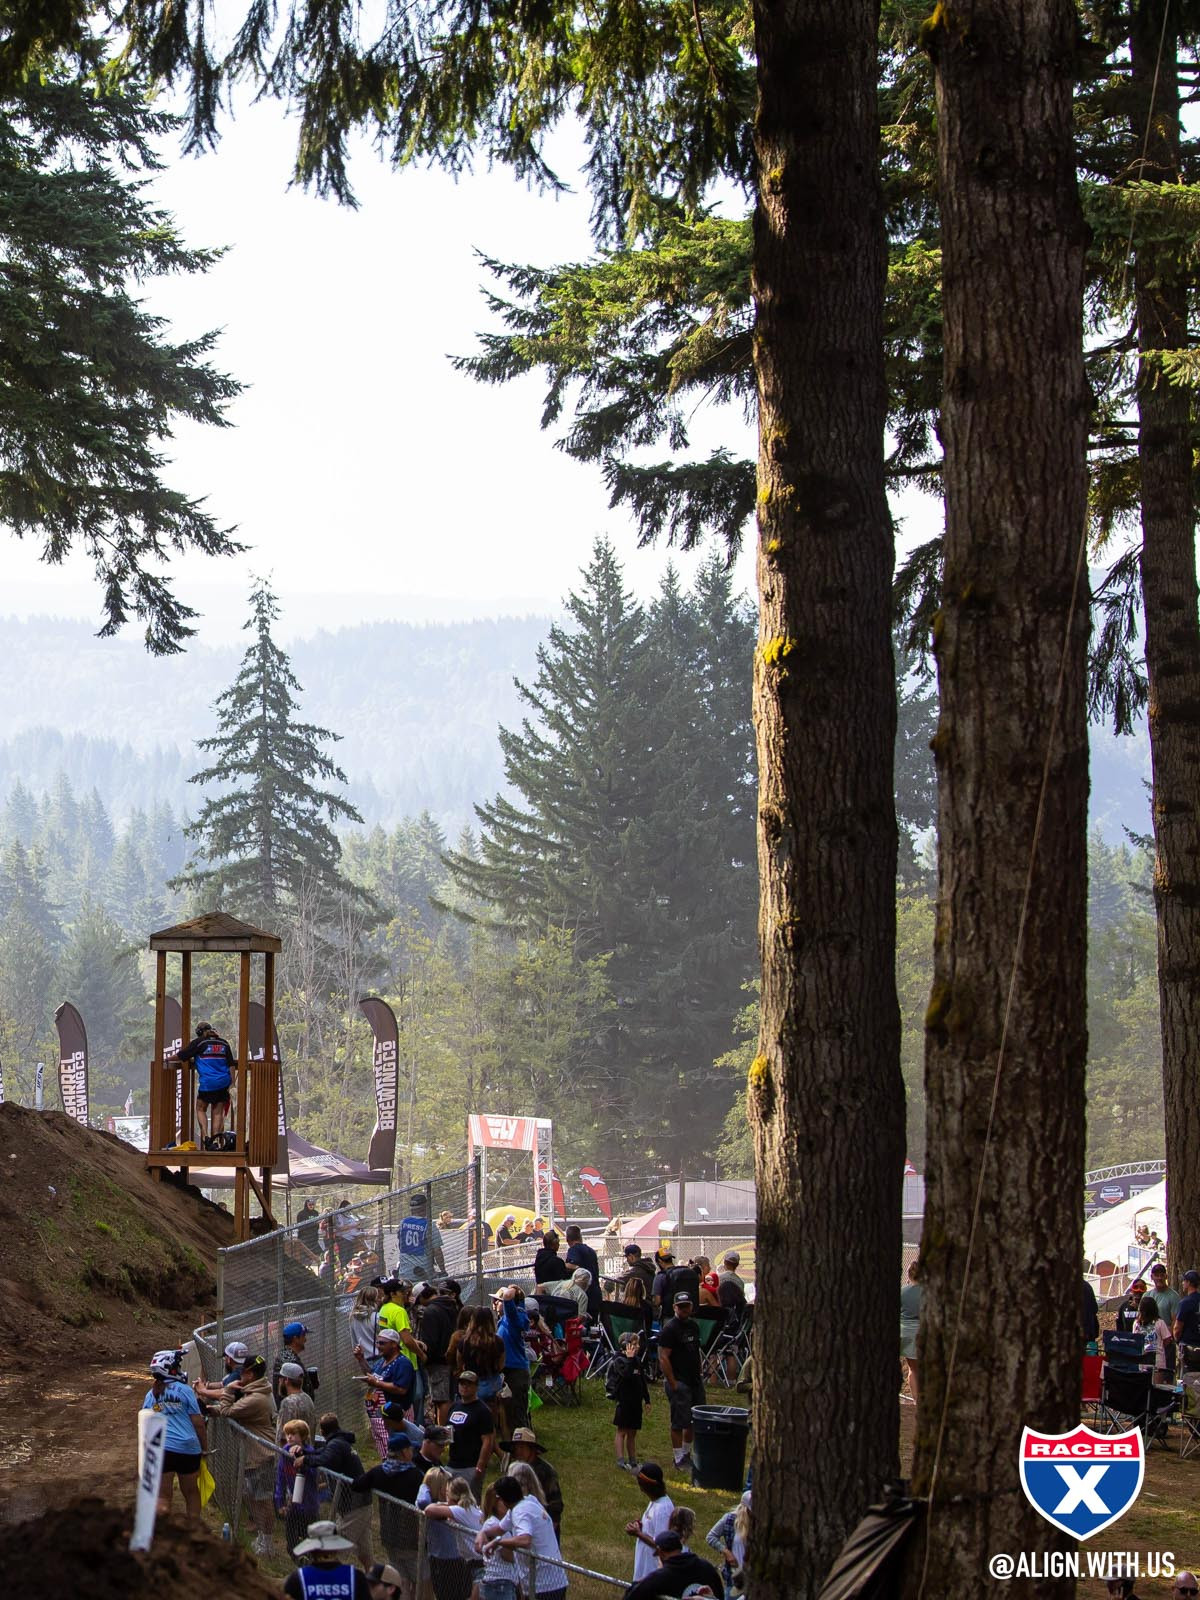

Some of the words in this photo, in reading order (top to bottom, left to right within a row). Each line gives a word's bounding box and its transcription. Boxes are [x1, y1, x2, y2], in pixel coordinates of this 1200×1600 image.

[74, 1070, 88, 1126] REWING
[486, 1118, 519, 1140] FLY
[403, 1223, 425, 1231] PRESS
[405, 1230, 419, 1247] 60
[307, 1584, 350, 1596] PRESS
